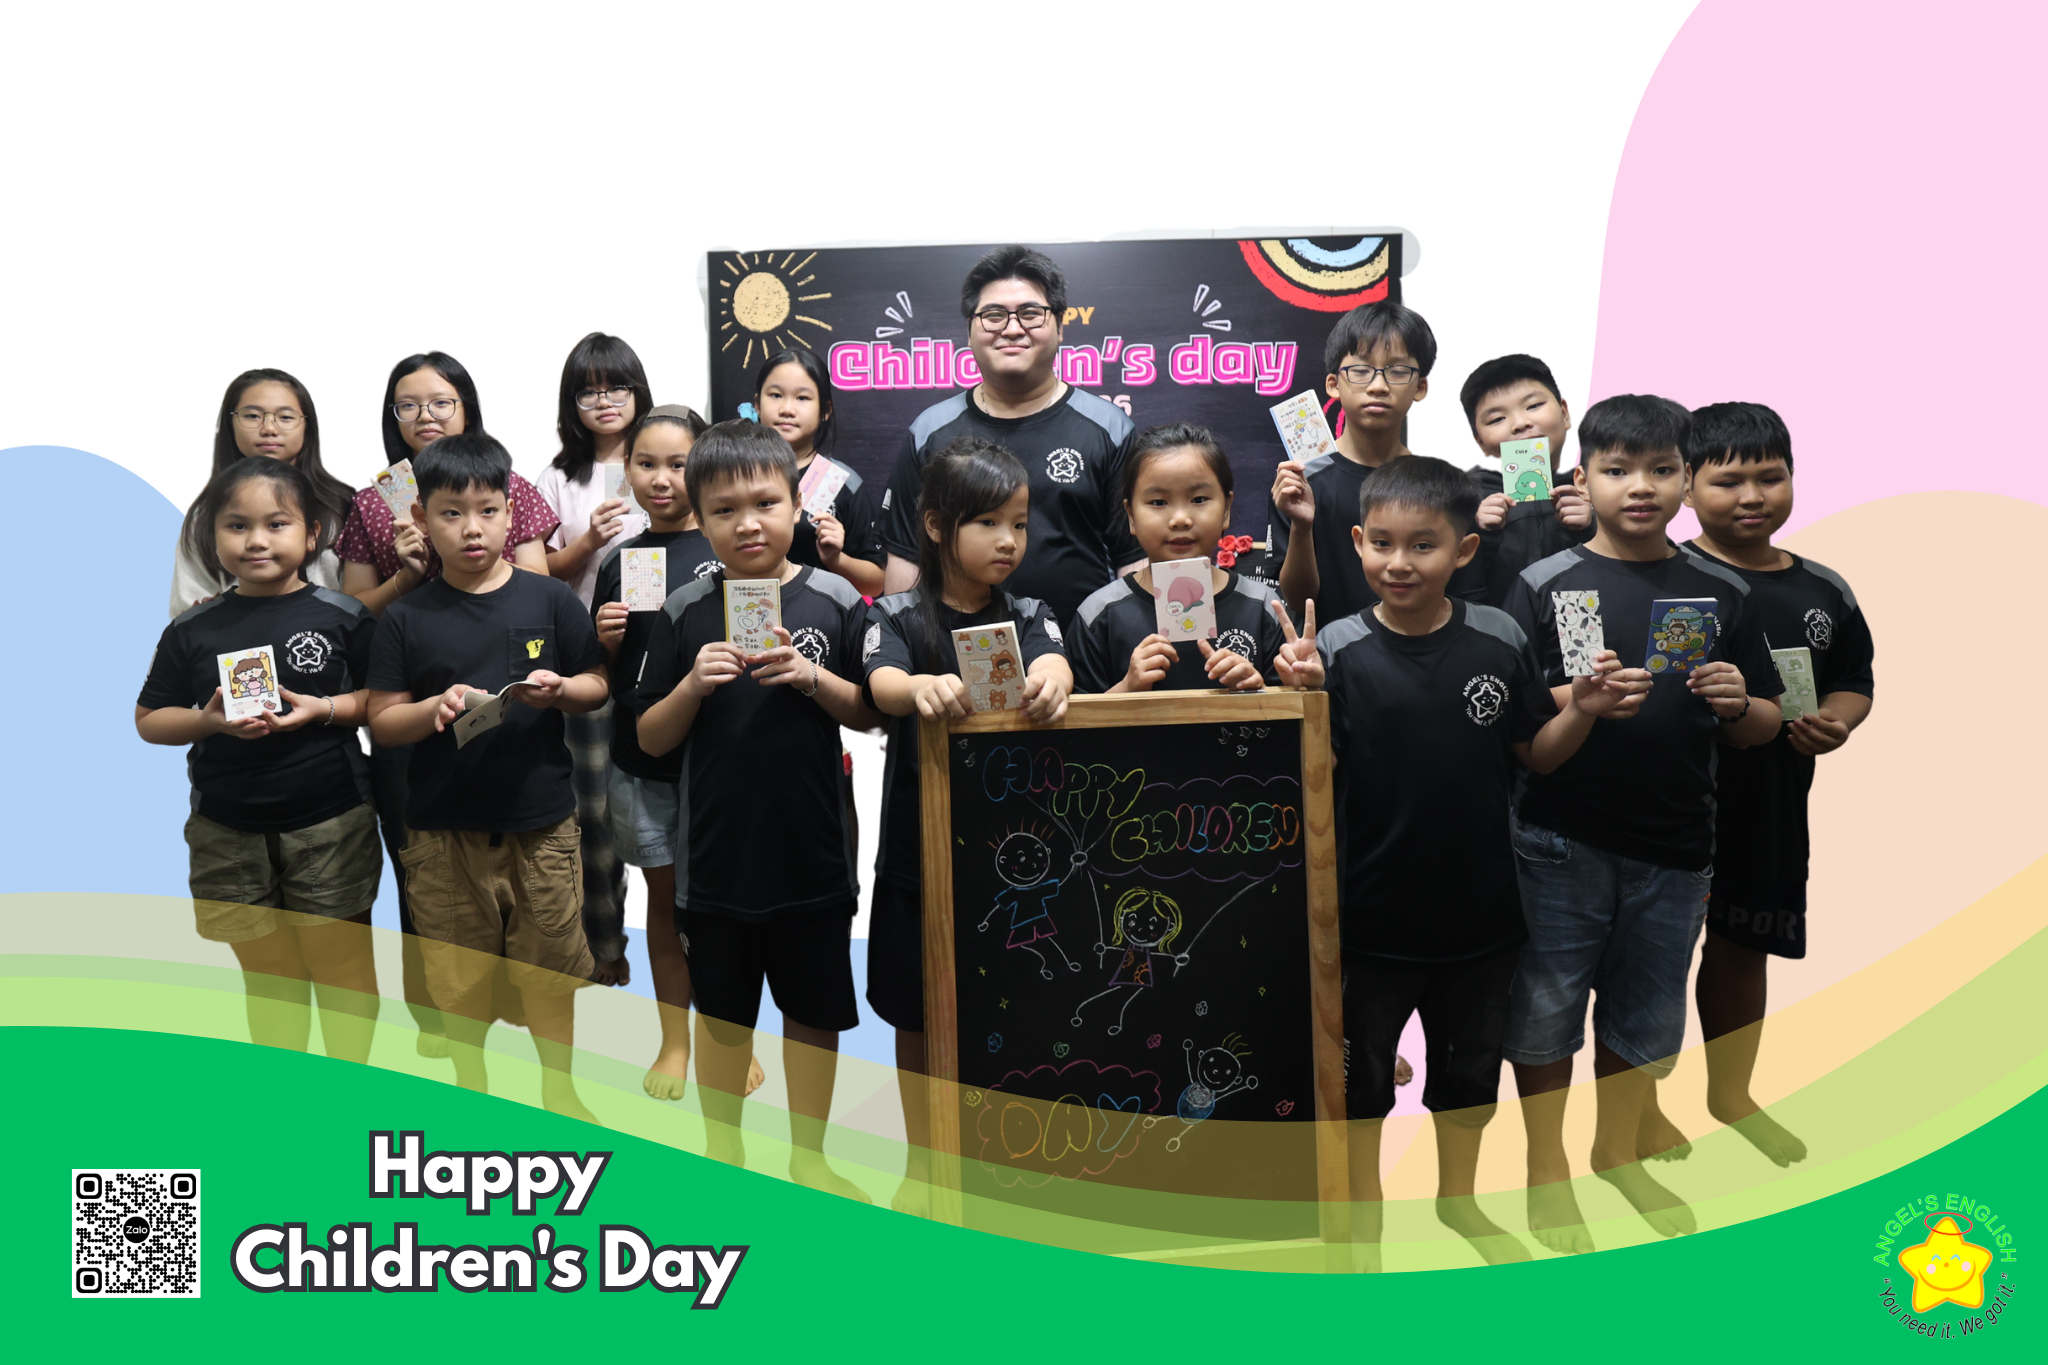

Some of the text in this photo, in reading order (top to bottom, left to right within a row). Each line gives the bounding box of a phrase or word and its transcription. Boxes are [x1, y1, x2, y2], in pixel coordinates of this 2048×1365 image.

[1168, 334, 1299, 396] day
[983, 746, 1146, 819] HAPPY
[1111, 802, 1300, 862] CHILDREN
[1000, 1093, 1141, 1161] DAY
